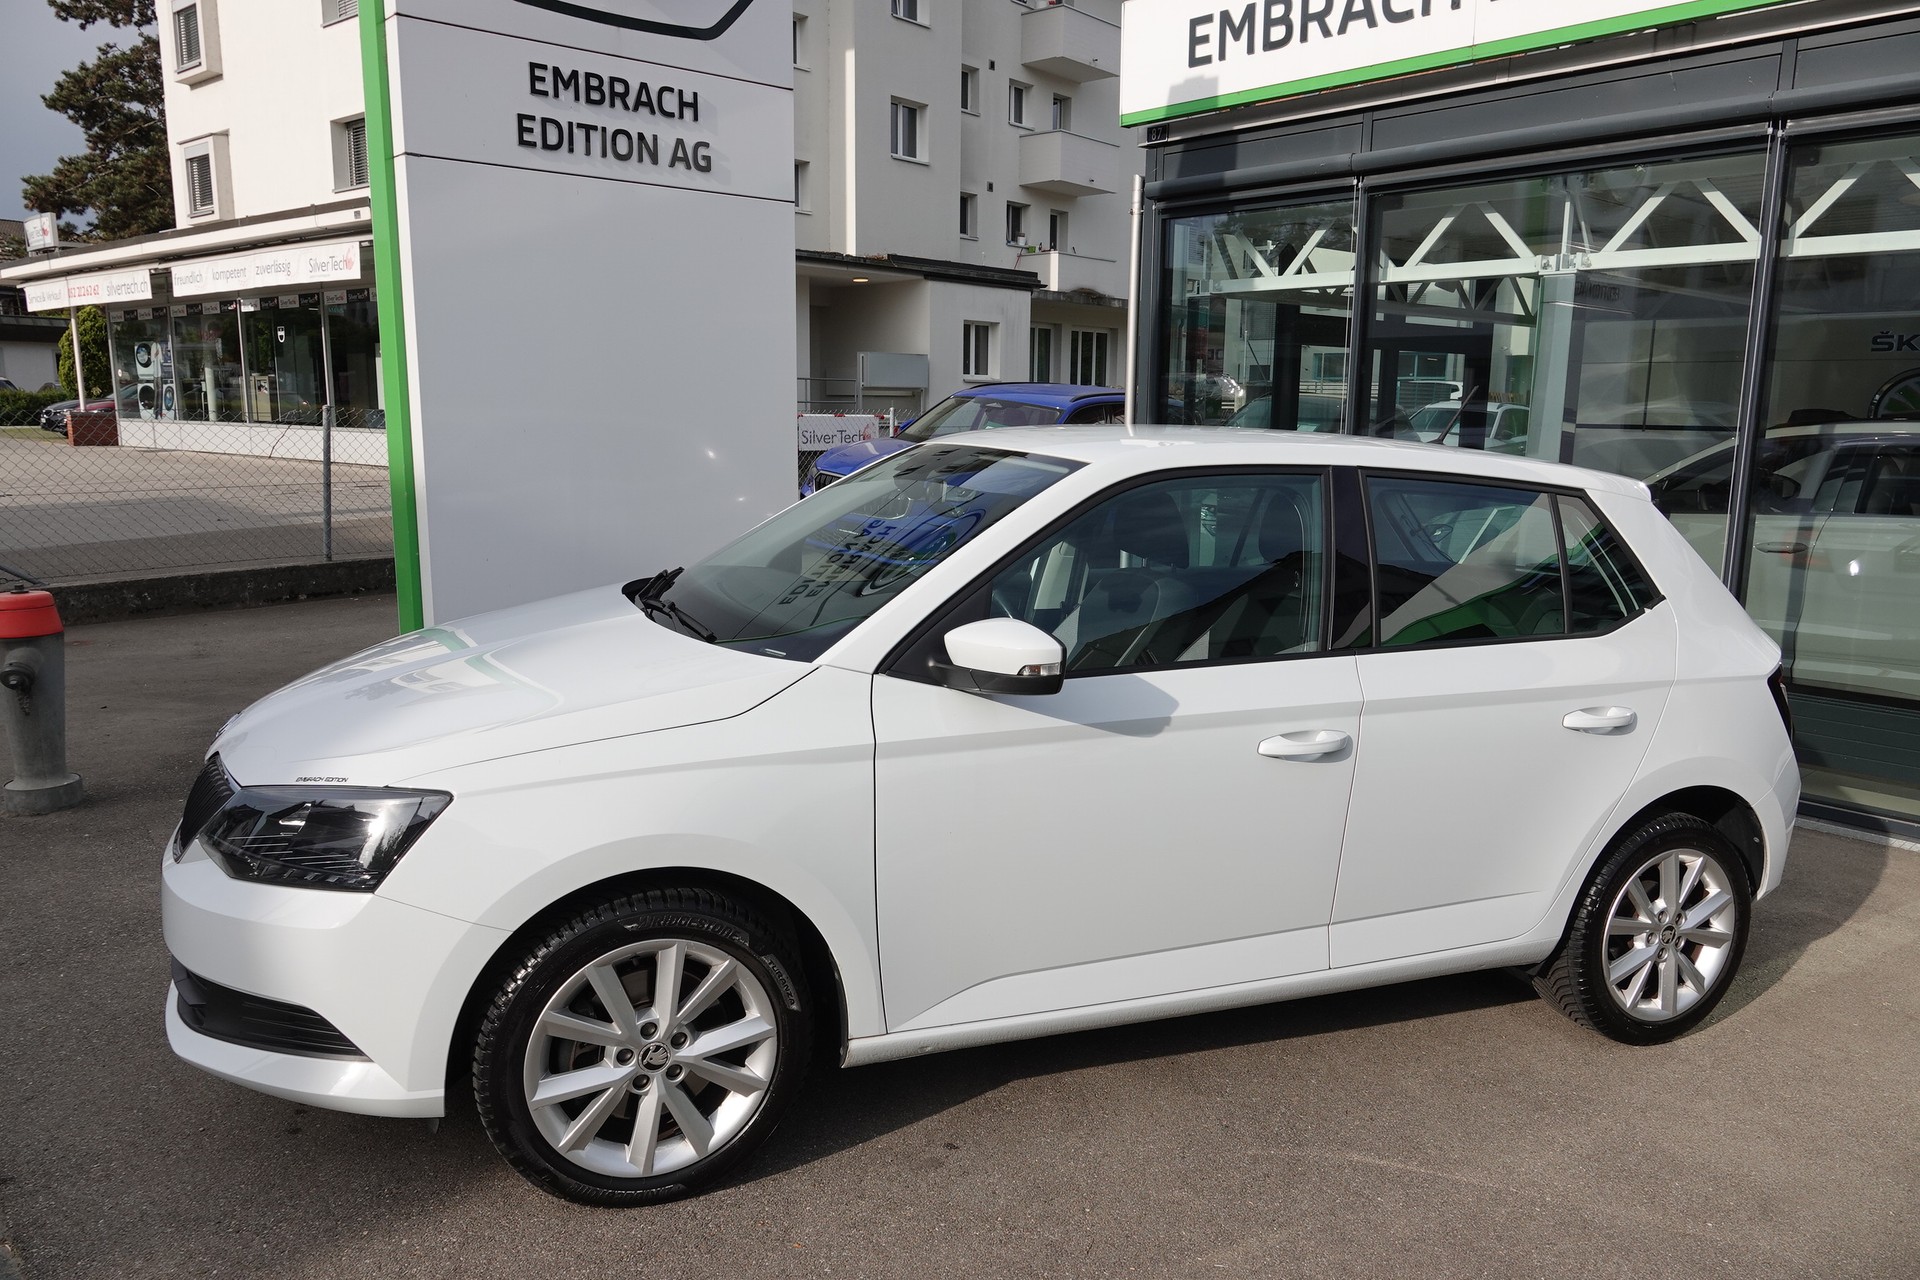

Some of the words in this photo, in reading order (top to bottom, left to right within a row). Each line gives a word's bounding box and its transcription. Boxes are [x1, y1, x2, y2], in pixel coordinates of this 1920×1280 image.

[1188, 0, 1461, 68] EMBRA
[529, 61, 699, 122] EMBRACH
[517, 113, 659, 165] EDITION
[669, 138, 712, 173] AG
[1151, 128, 1163, 140] 87
[107, 276, 148, 297] silvertech.ch
[174, 272, 203, 286] freundlich
[212, 267, 247, 284] kompetent
[255, 260, 291, 276] zuverlässig
[308, 255, 347, 273] SilverTech
[801, 429, 864, 445] SilverTech
[768, 959, 796, 1006] TURANZA
